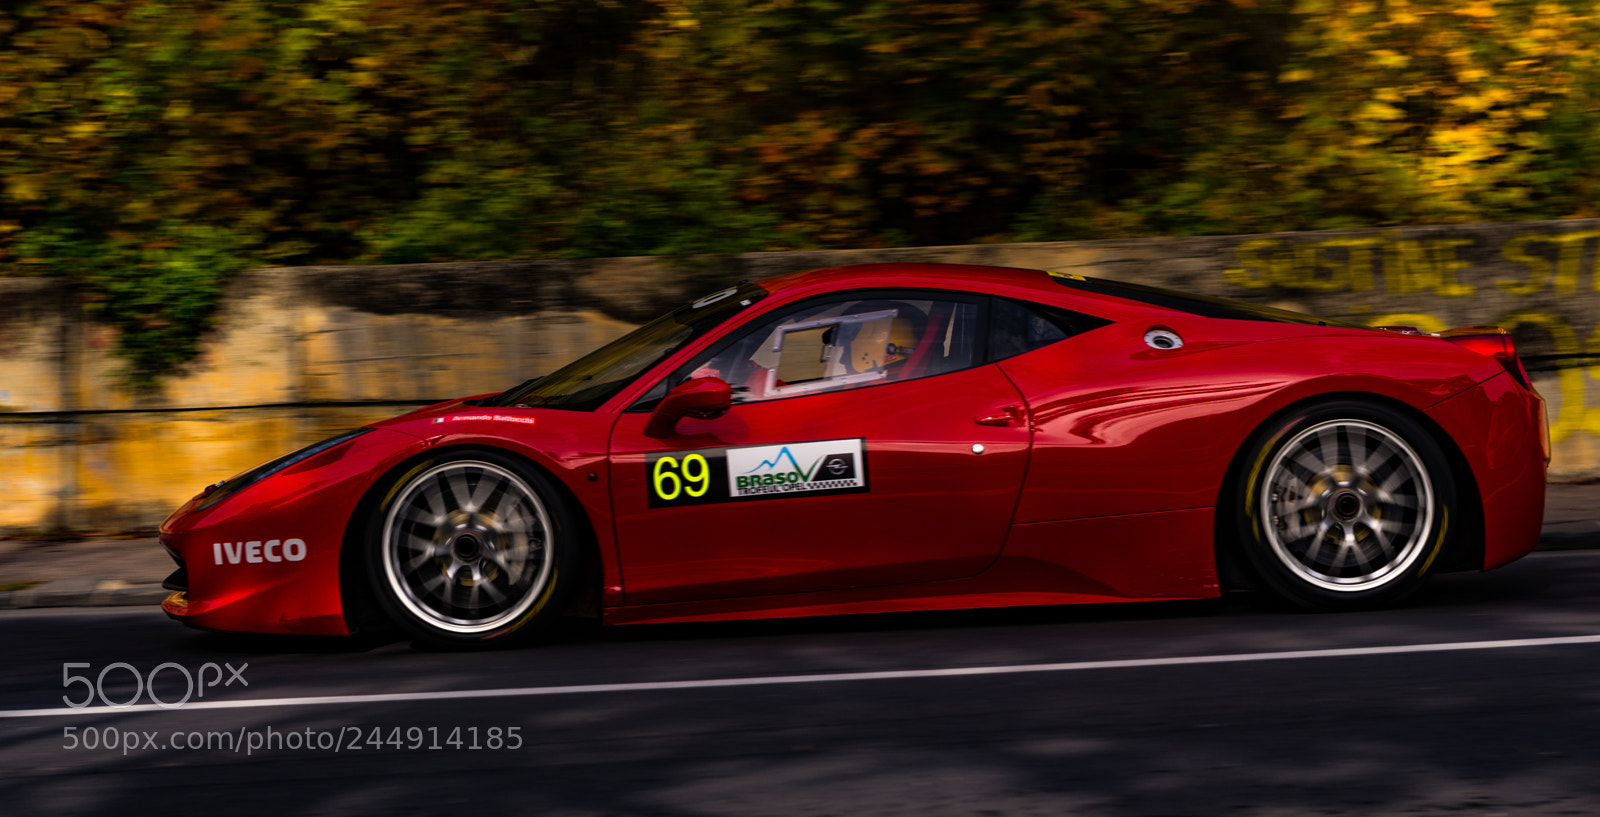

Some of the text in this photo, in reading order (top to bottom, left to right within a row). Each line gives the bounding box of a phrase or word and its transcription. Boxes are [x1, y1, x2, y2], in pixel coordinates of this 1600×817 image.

[653, 453, 710, 500] 69
[782, 482, 807, 492] OPEL
[213, 538, 307, 566] IVECO
